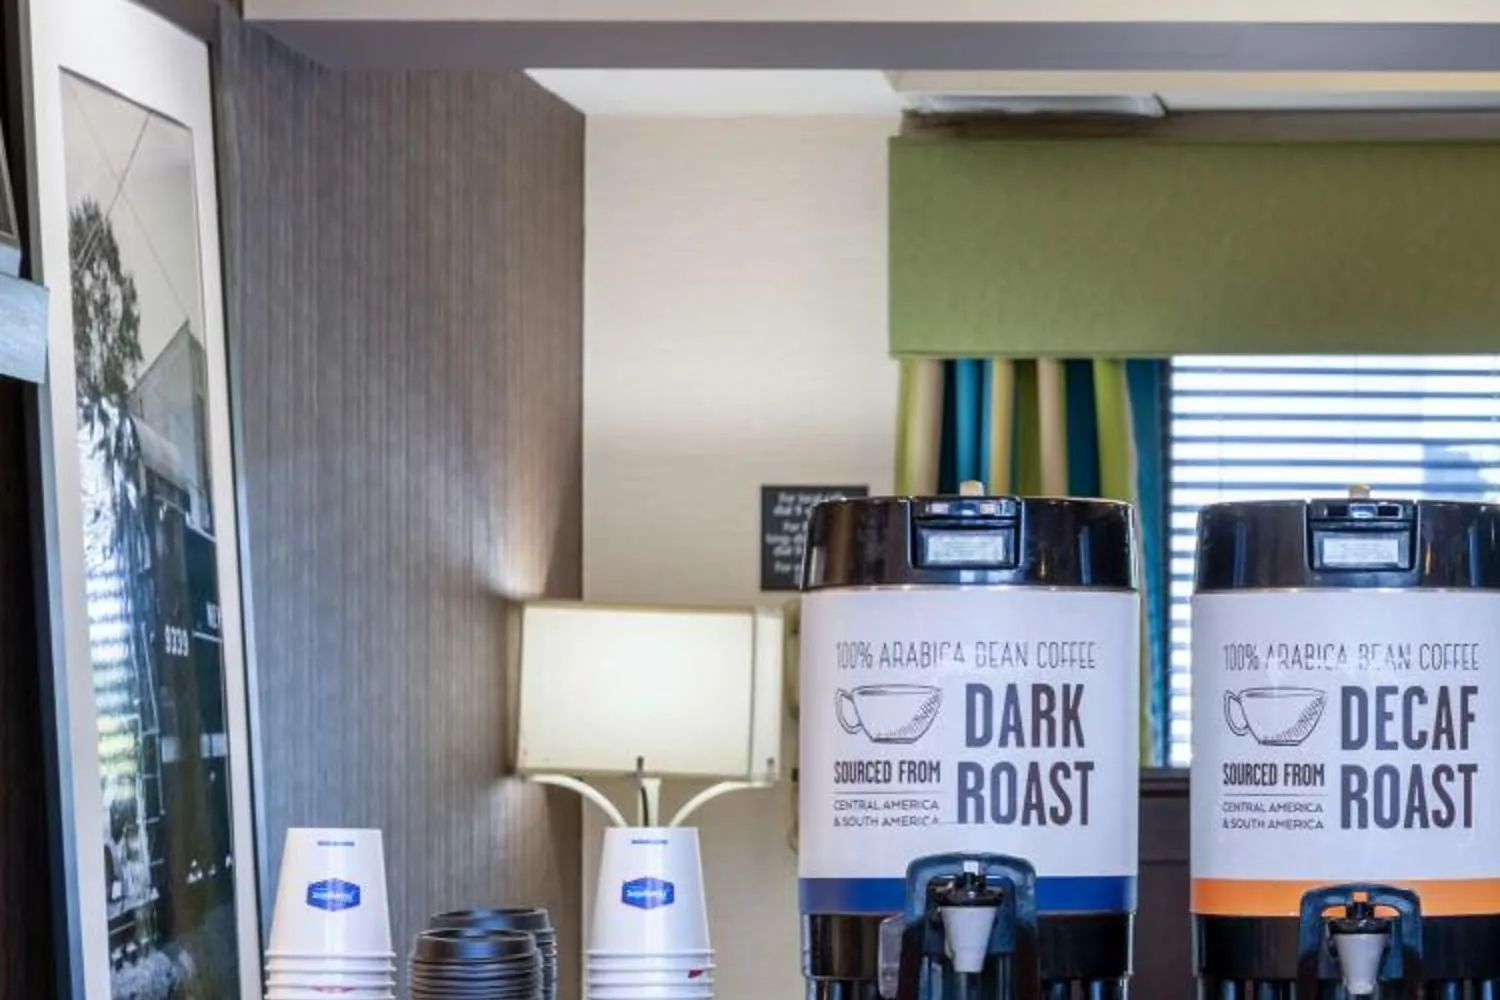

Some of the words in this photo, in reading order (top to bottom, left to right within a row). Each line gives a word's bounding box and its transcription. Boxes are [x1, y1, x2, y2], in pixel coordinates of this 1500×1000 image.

[837, 640, 873, 669] 100%
[975, 640, 1028, 668] BEAN
[1037, 640, 1096, 669] COFFEE
[1223, 643, 1260, 672] 100%
[1419, 643, 1480, 671] COFFEE
[965, 682, 1085, 749] DARK
[1340, 685, 1479, 751] DECAF
[834, 759, 893, 785] SOURCED
[898, 759, 941, 785] FROM
[1222, 762, 1278, 788] SOURCED
[1283, 762, 1325, 788] FROM
[833, 799, 879, 811] CENTRAL
[883, 799, 939, 811] AMERICA
[956, 760, 1095, 828] ROAST
[1222, 801, 1266, 813] CENTRAL
[1268, 801, 1324, 813] AMERICA
[1340, 763, 1479, 830] ROAST
[842, 815, 879, 827] SOUTH
[881, 814, 939, 827] AMERICA
[1267, 818, 1324, 830] AMERICA
